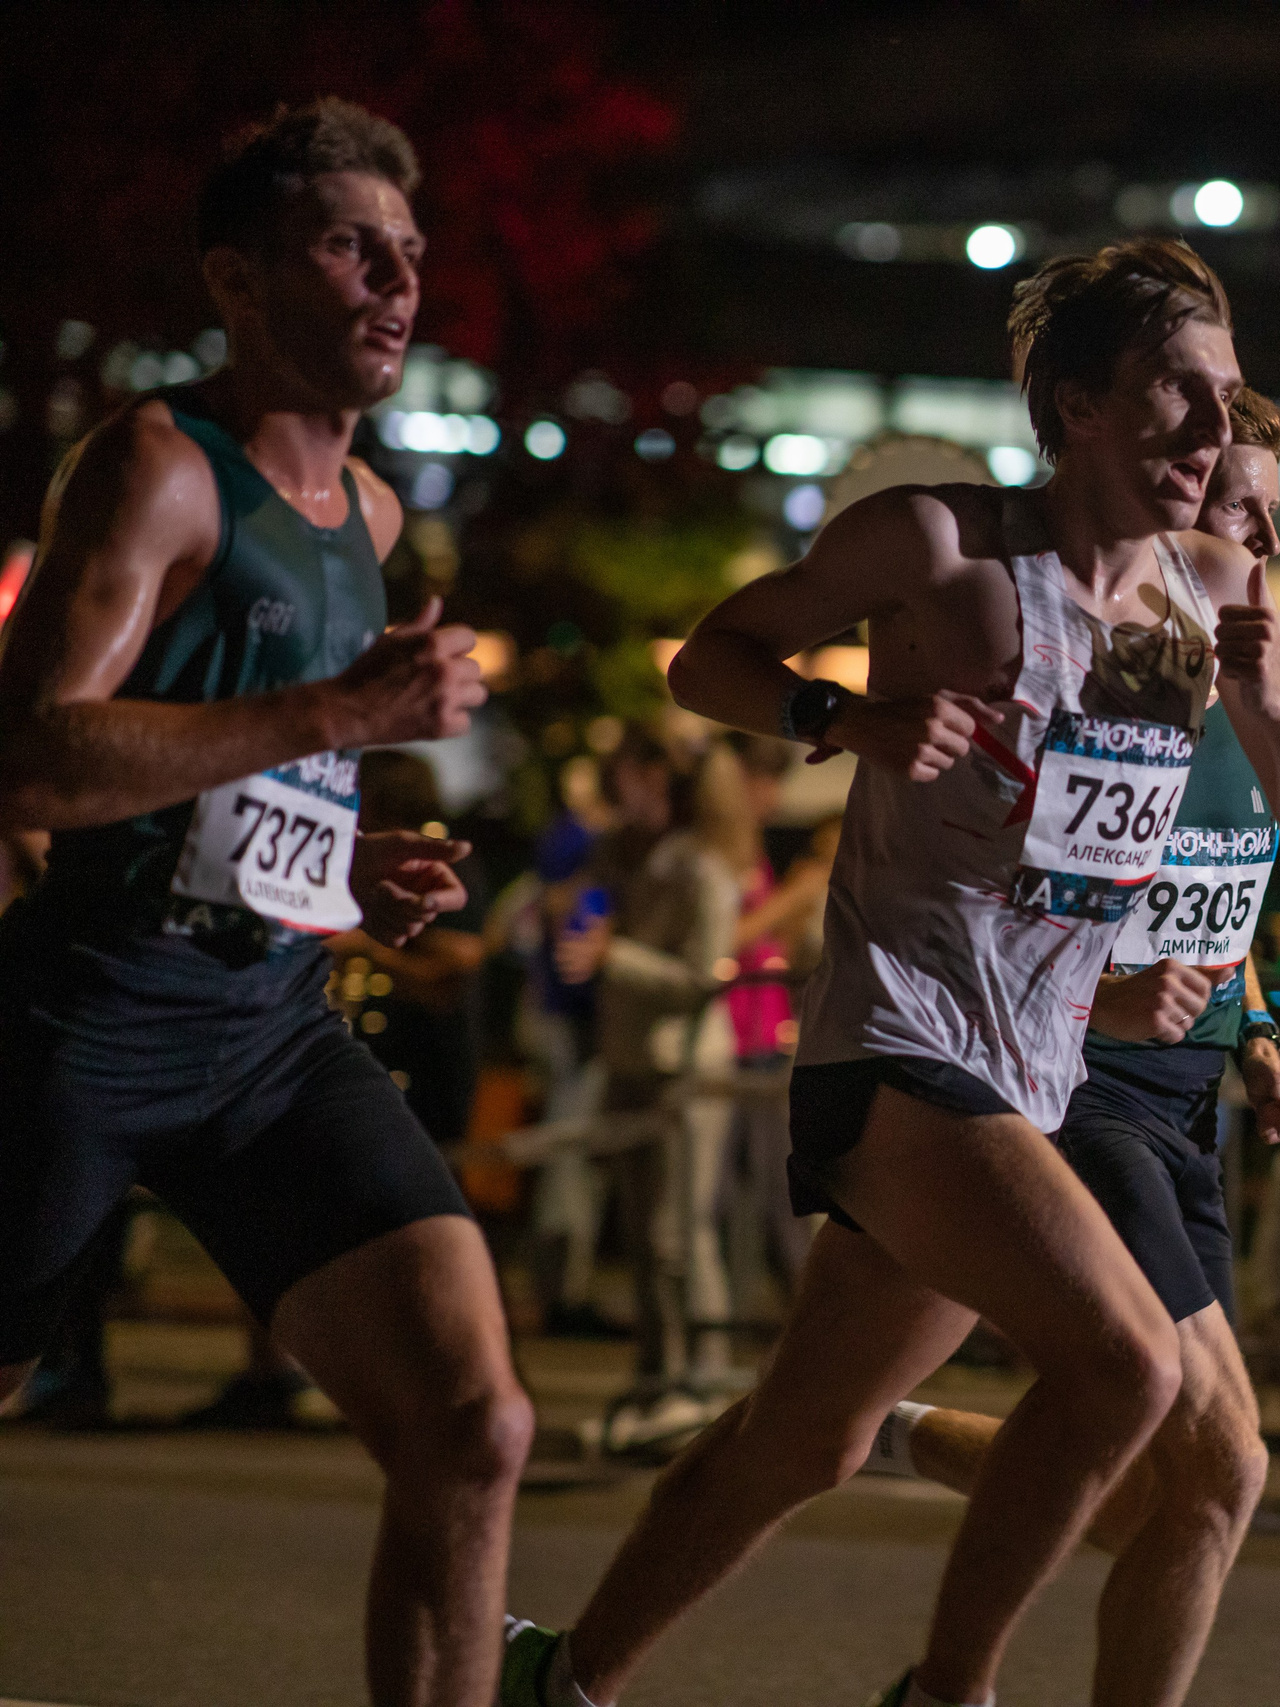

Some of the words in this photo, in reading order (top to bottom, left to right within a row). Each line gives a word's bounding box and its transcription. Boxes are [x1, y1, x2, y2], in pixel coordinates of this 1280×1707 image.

[1064, 773, 1180, 843] 7366
[229, 793, 336, 888] 7373
[1147, 879, 1257, 934] 9305
[1158, 936, 1231, 957] ДМИТРИЙ
